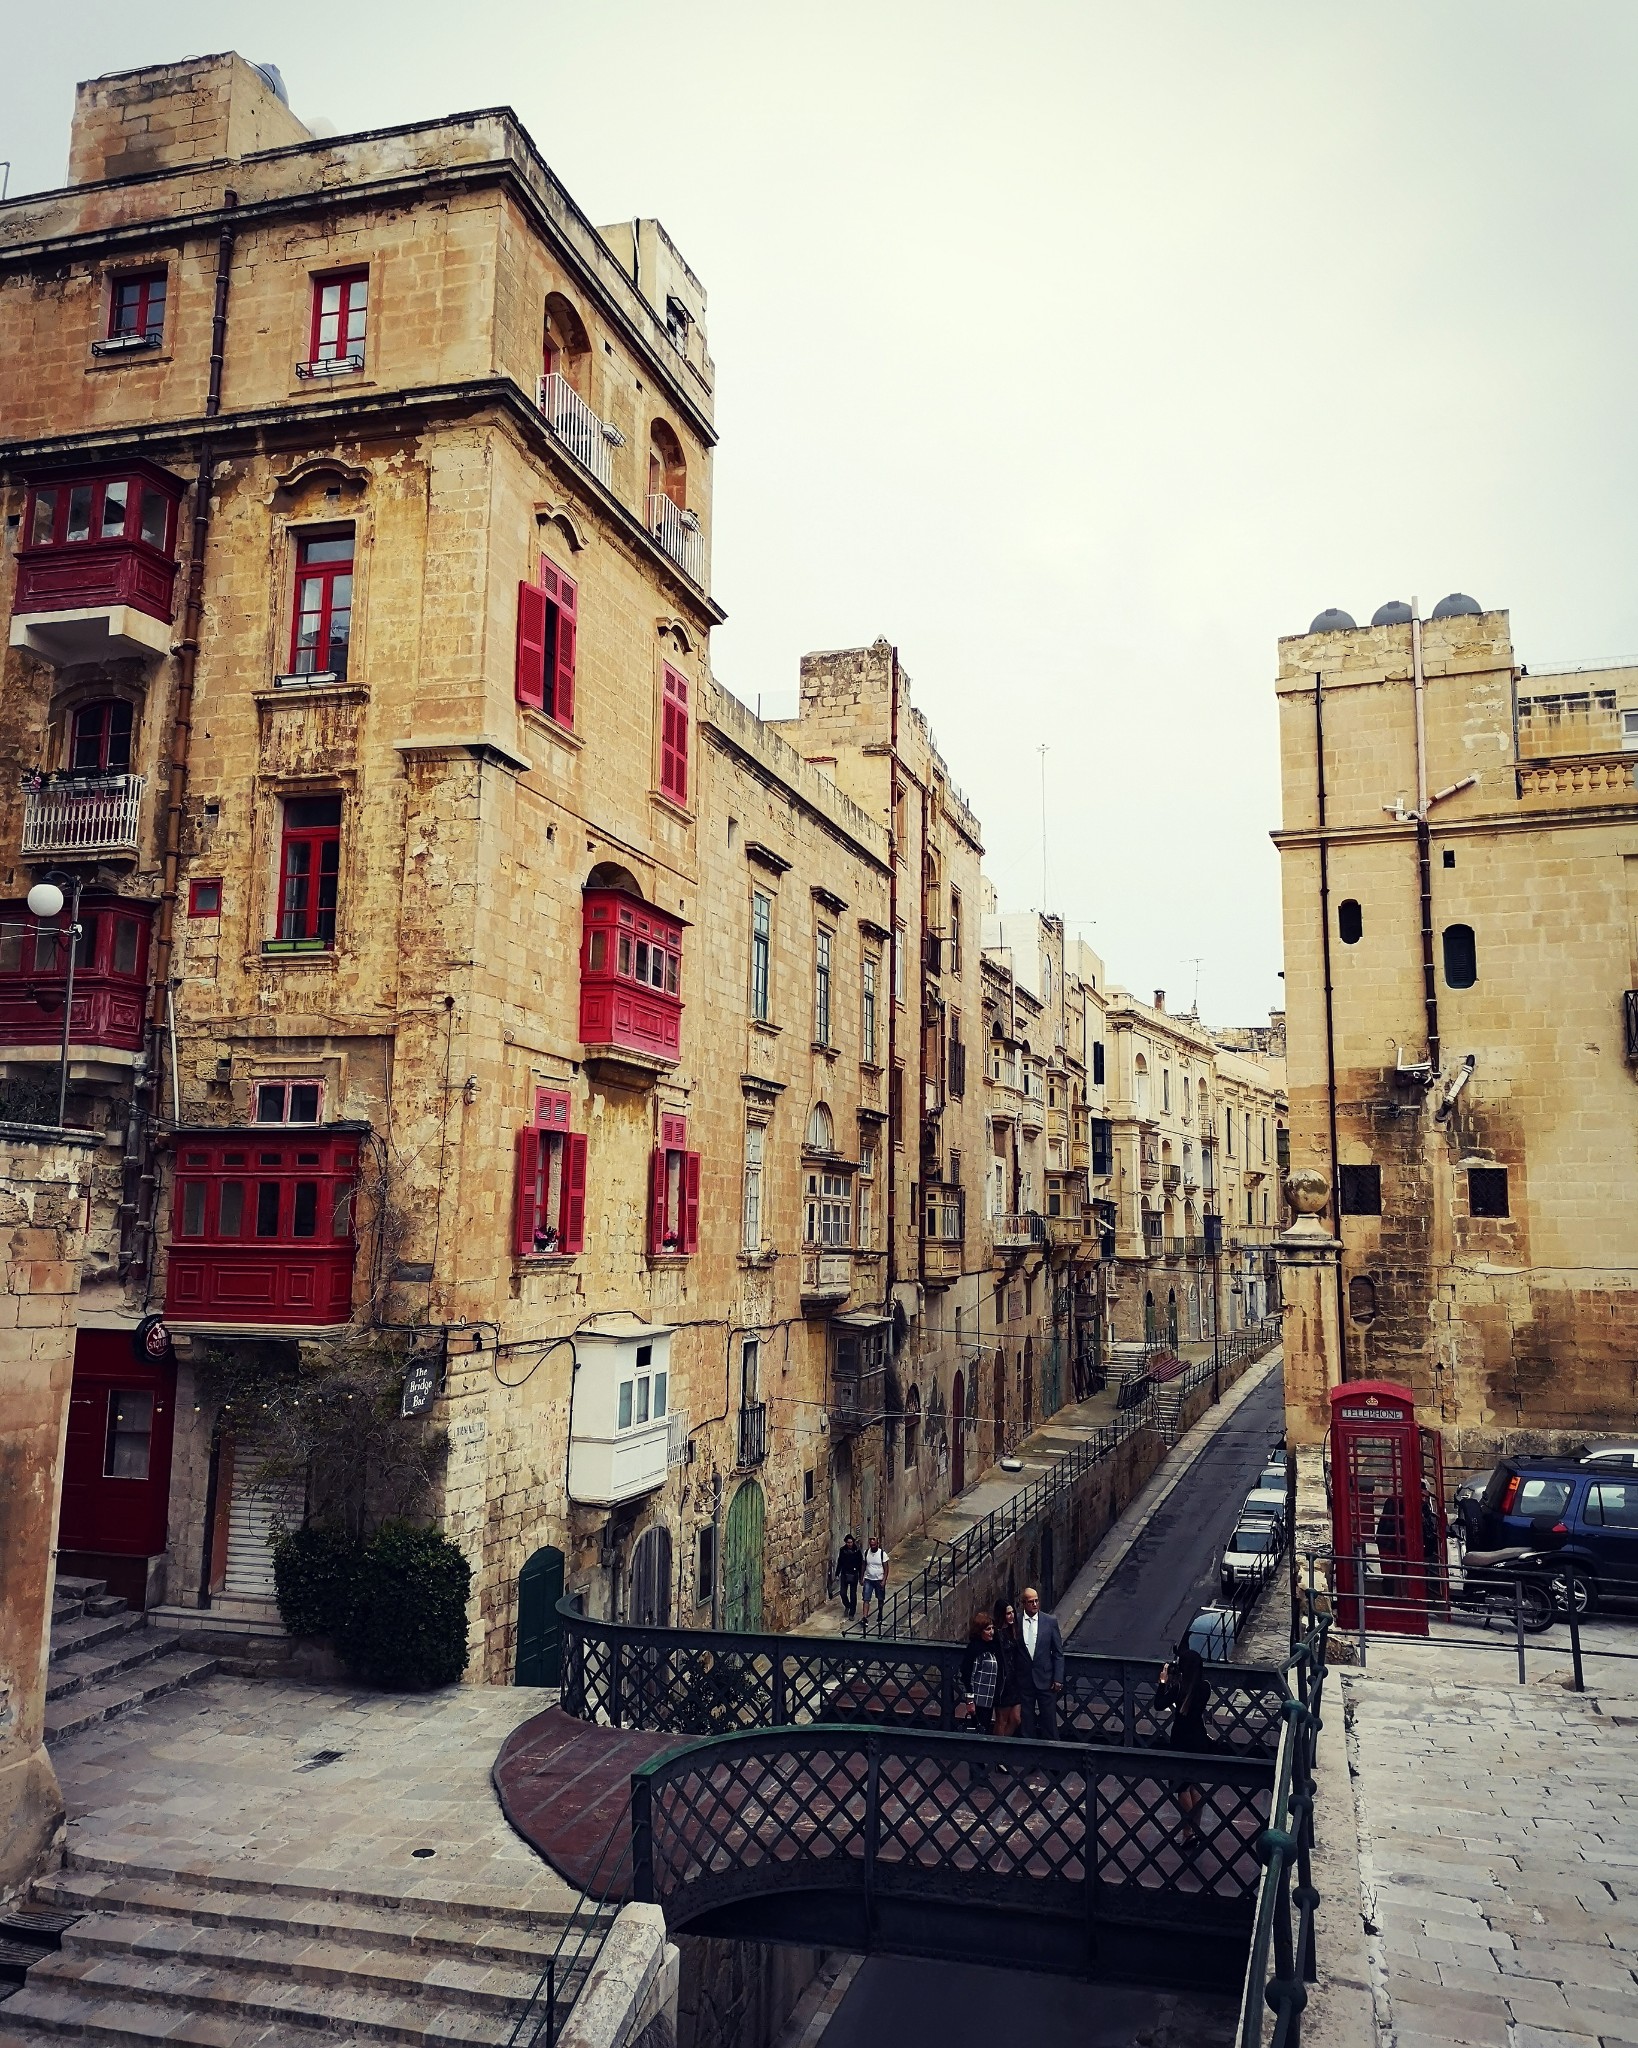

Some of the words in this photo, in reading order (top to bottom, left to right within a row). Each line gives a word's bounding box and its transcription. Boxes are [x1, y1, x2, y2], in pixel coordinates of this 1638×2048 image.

[415, 1367, 428, 1378] The
[409, 1378, 433, 1396] Bridge
[412, 1395, 426, 1408] Bar
[1344, 1409, 1401, 1419] TELEPHONE
